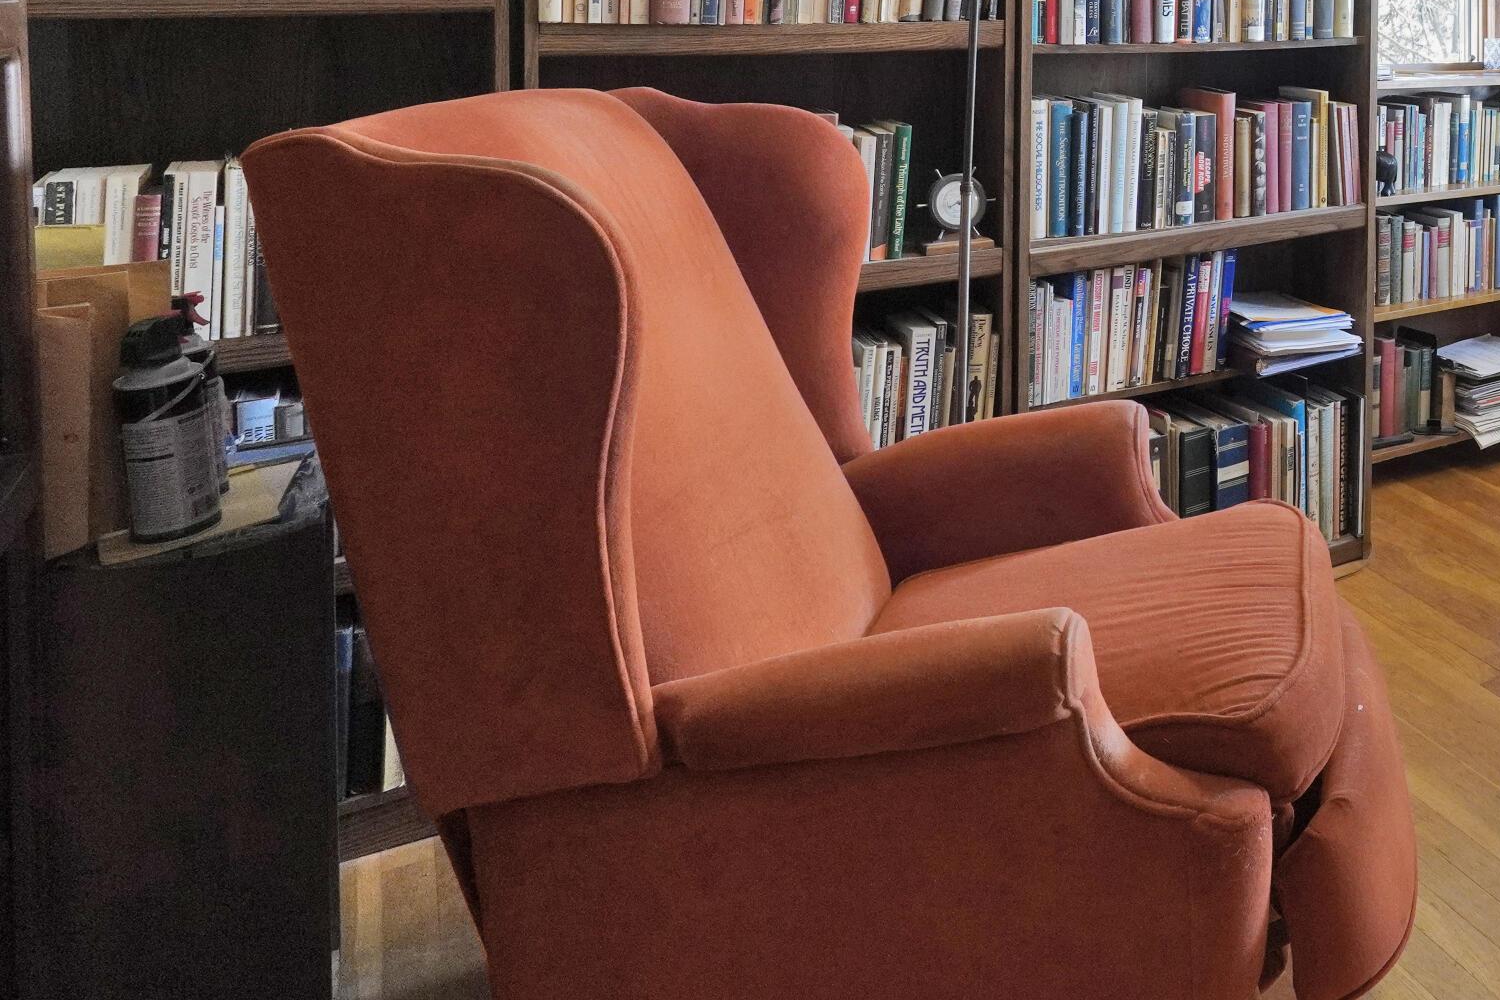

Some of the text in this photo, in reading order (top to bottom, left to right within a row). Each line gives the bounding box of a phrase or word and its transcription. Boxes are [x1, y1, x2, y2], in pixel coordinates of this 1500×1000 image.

[1181, 1, 1189, 32] BATTLE
[1056, 137, 1068, 178] Sociological
[896, 164, 907, 194] Triumph
[203, 190, 212, 200] The
[898, 196, 905, 204] of
[202, 202, 212, 224] Witness
[893, 218, 903, 235] Laity
[1184, 283, 1195, 322] PRIVATE
[1180, 325, 1191, 362] CHOICE
[911, 338, 930, 434] TRUTH AND METH
